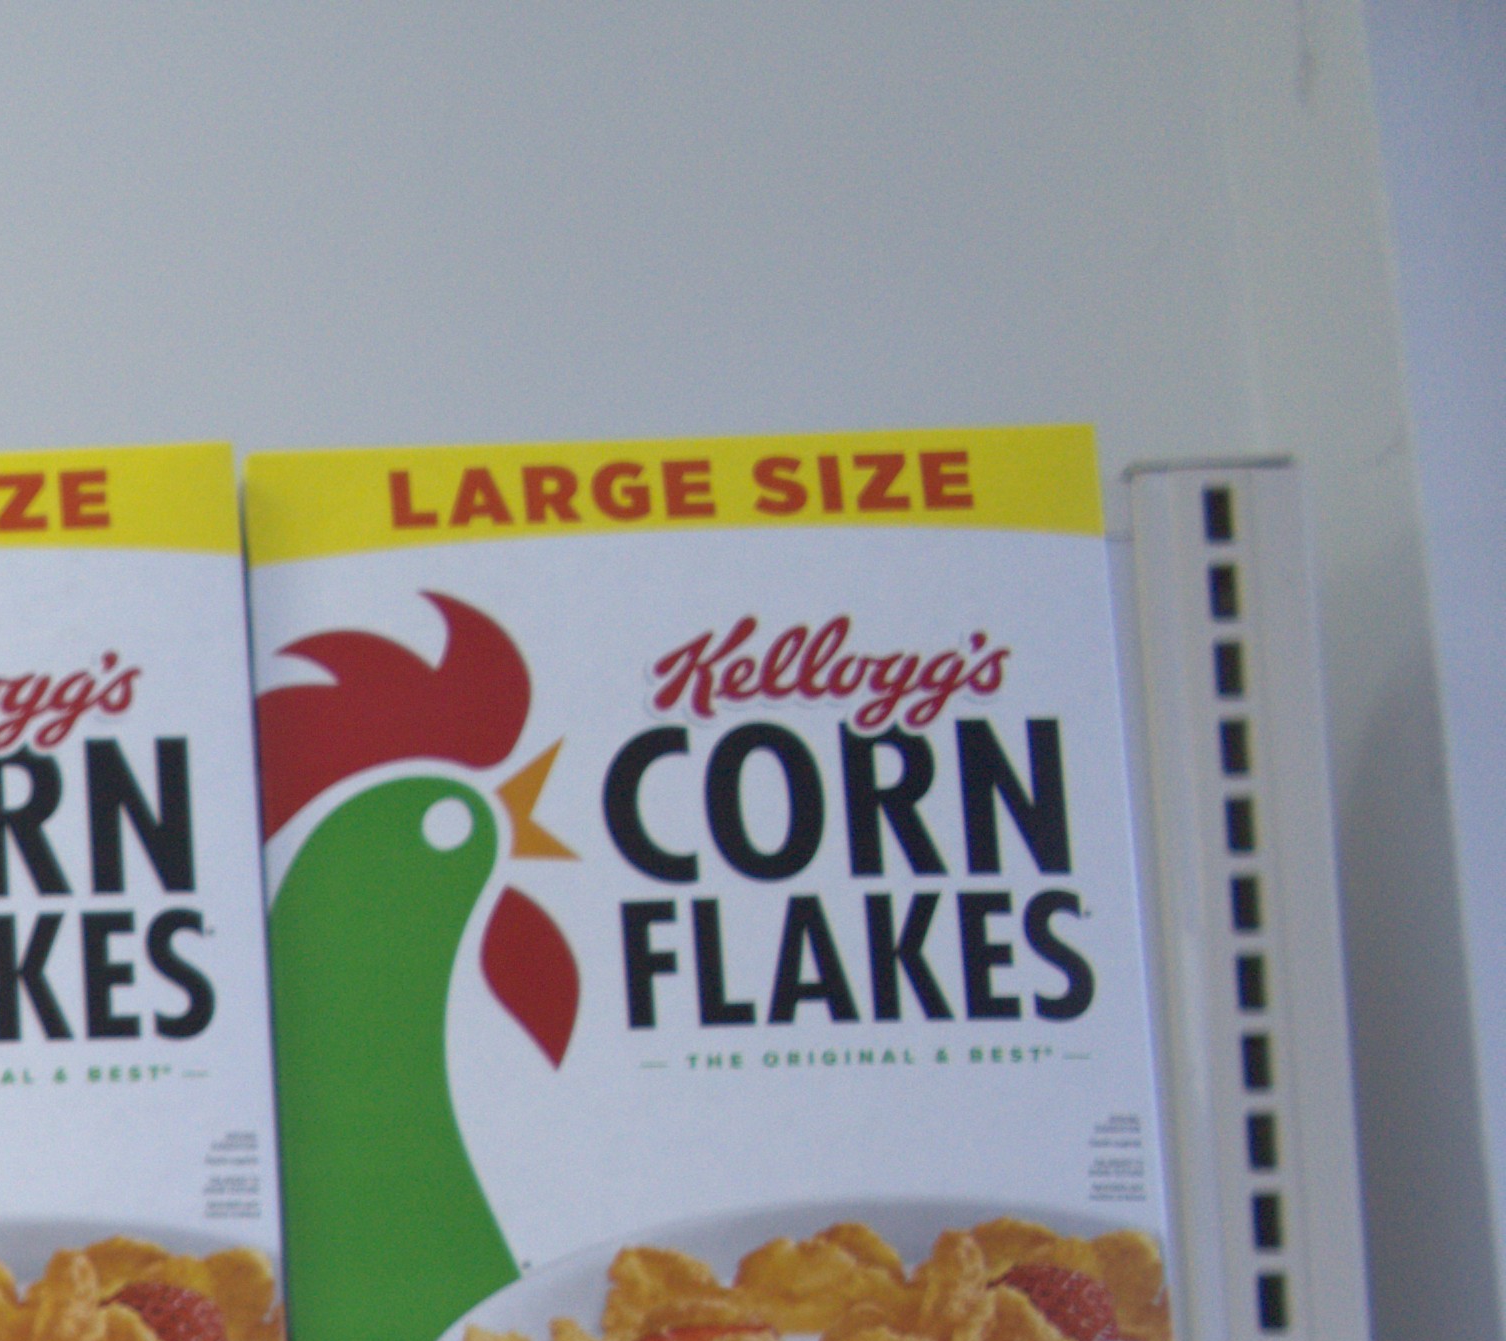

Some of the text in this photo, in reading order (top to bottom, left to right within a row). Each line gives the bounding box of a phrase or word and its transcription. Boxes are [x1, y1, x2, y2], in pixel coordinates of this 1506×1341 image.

[388, 449, 976, 531] LARGE SIZE
[651, 615, 1012, 731] Kellogg's
[601, 717, 1073, 885] CORN
[620, 890, 1096, 1031] FLAKES
